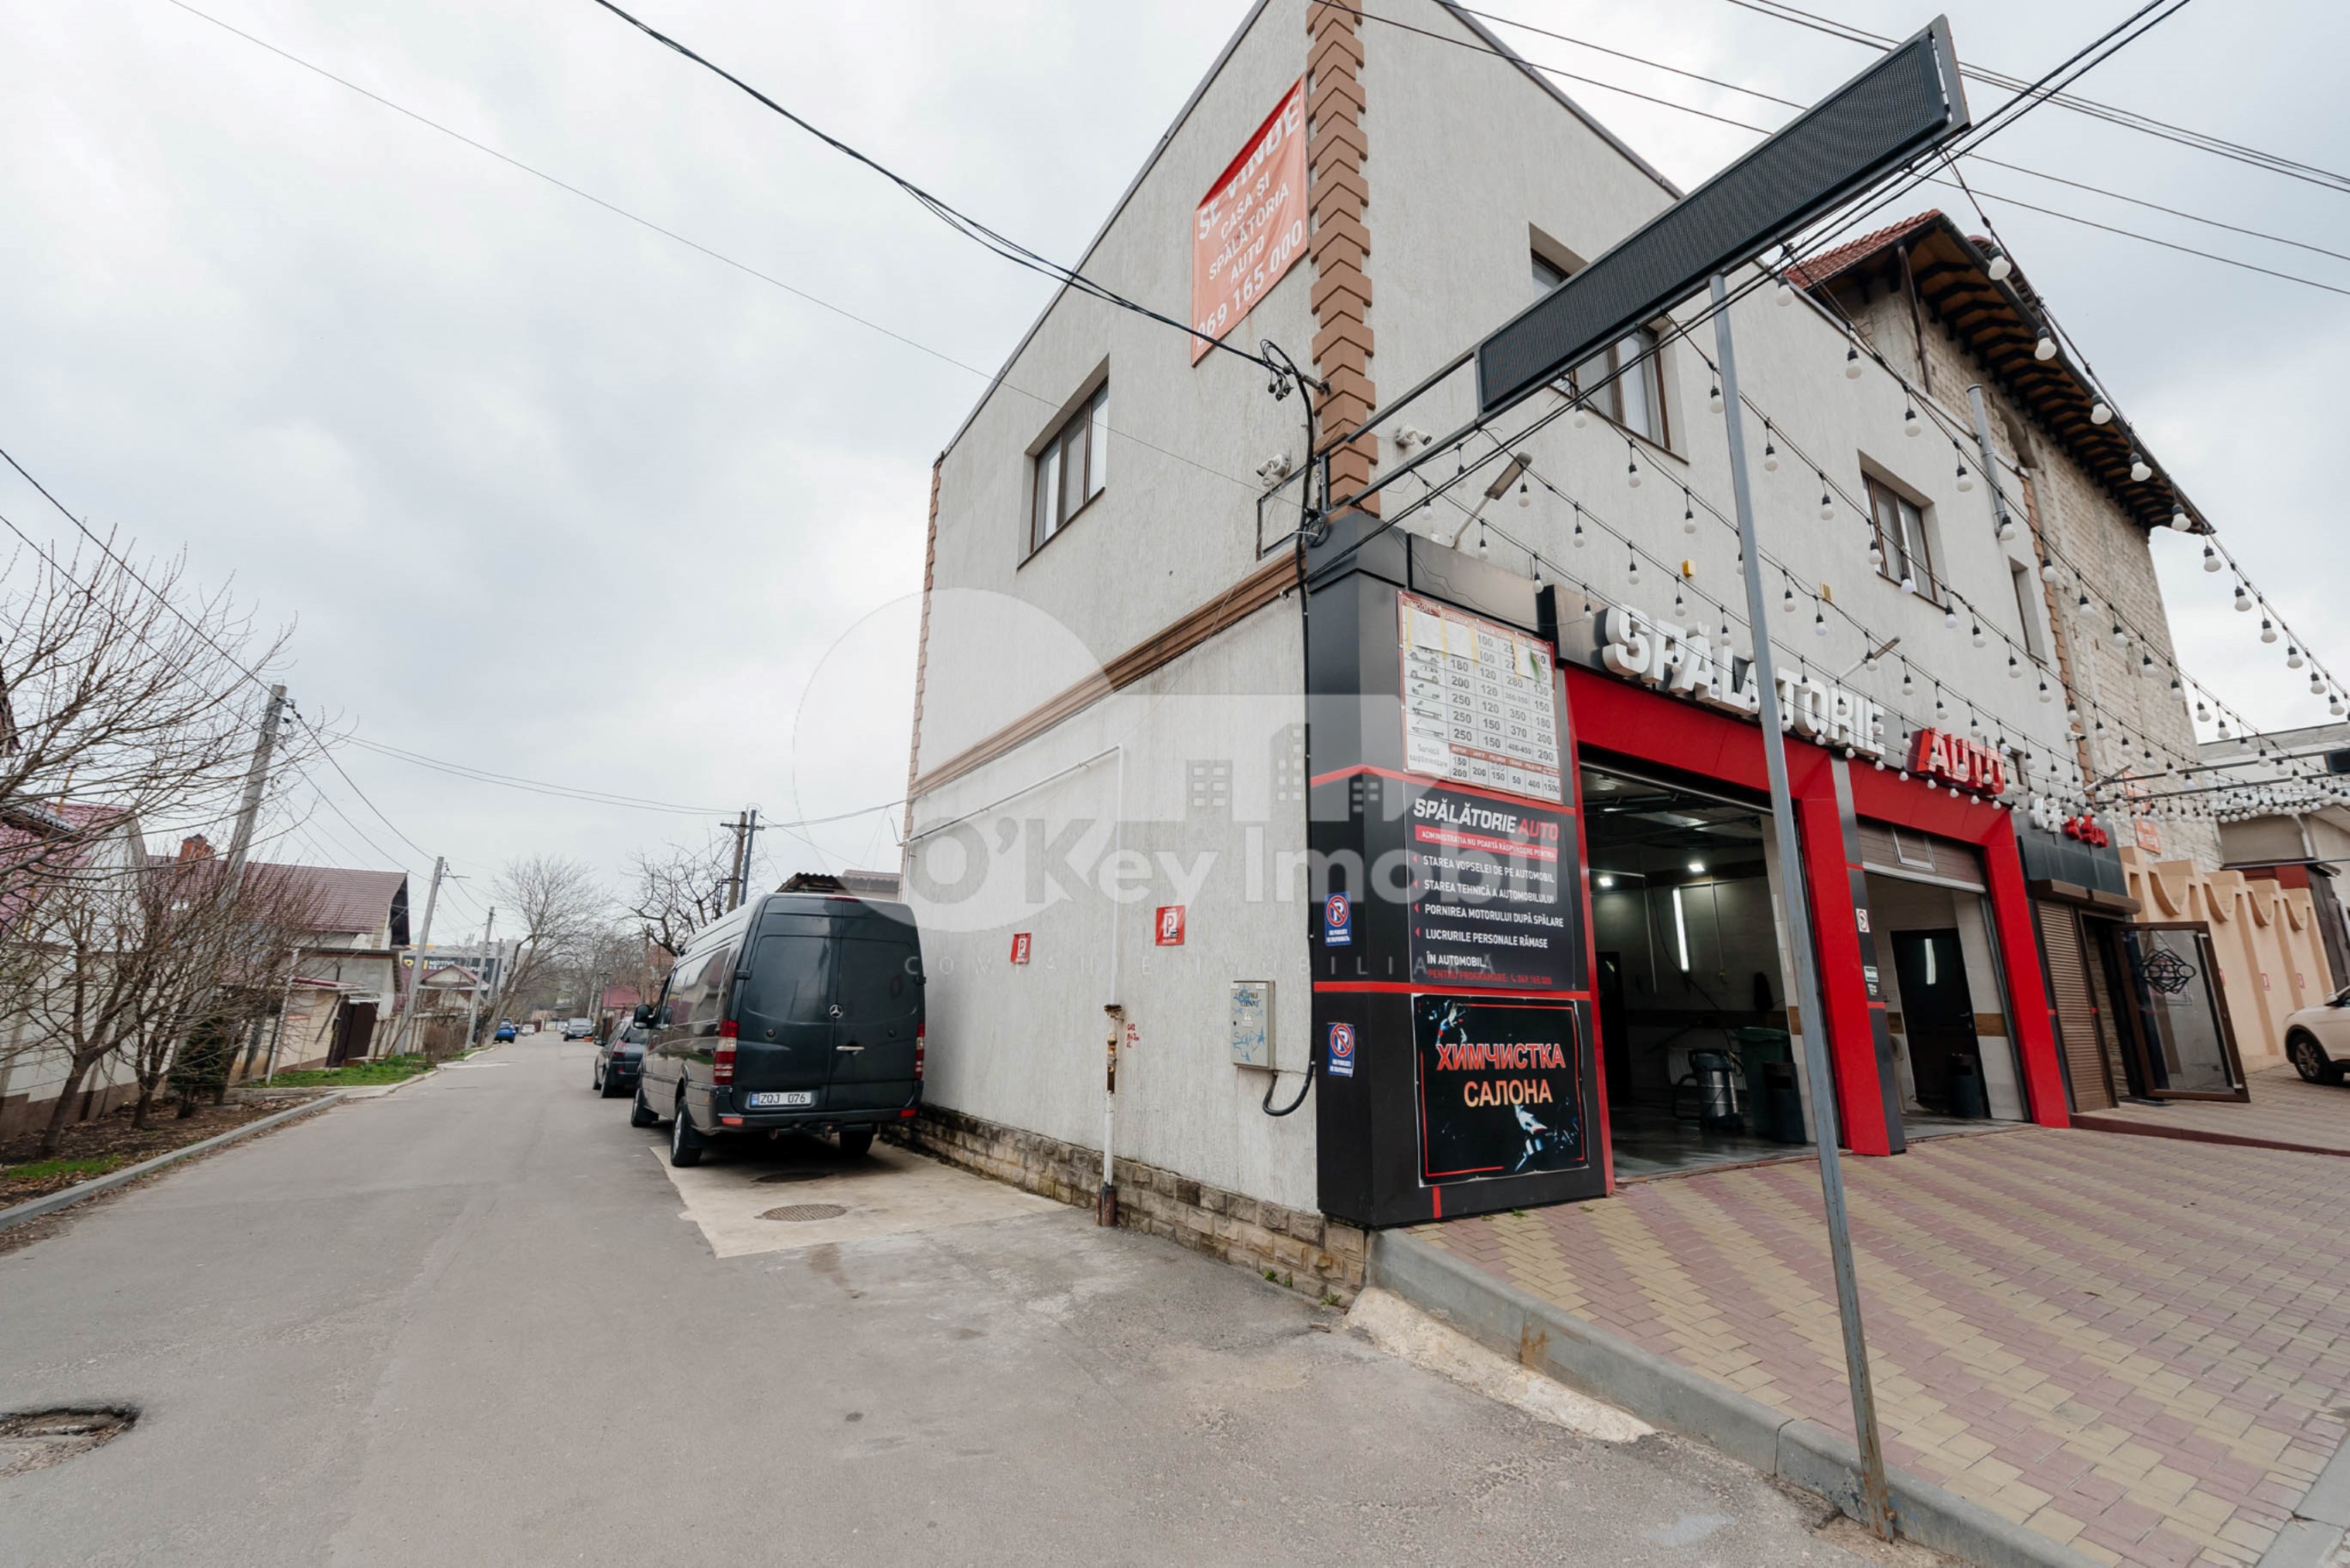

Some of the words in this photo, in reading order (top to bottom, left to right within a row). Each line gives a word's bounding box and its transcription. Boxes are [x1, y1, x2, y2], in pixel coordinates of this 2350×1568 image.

[1199, 199, 1221, 241] SE
[1208, 183, 1289, 282] SPĂLĂTORIA
[1221, 198, 1254, 240] CASA
[1230, 235, 1264, 285] AUTO
[1196, 302, 1228, 346] 069
[1233, 267, 1264, 312] 165
[1269, 219, 1303, 273] 000
[1477, 635, 1494, 647] 100
[1479, 651, 1495, 664] 100
[1451, 659, 1469, 672] 180
[1481, 668, 1497, 680] 120
[1507, 676, 1524, 688] 280
[1452, 676, 1470, 689] 200
[1481, 684, 1498, 696] 120
[1535, 700, 1549, 713] 150
[1452, 693, 1470, 707] 250
[1482, 701, 1500, 714] 120
[1509, 708, 1526, 721] 350
[1536, 717, 1551, 729] 180
[1453, 710, 1472, 724] 250
[1483, 718, 1501, 731] 150
[1511, 726, 1527, 738] 370
[1537, 732, 1552, 745] 200
[1453, 728, 1472, 742] 250
[1484, 736, 1501, 749] 150
[1538, 750, 1554, 763] 200
[1452, 757, 1467, 766] 150
[1916, 728, 2006, 794] AUTO
[1452, 768, 1468, 778] 200
[1472, 767, 1487, 777] 200
[1491, 771, 1506, 781] 150
[1512, 775, 1521, 785] 50
[1528, 780, 1541, 789] 400
[1413, 798, 1518, 834] SPĂLĂTORIE
[1518, 817, 1560, 841] AUTO
[1423, 855, 1455, 869] STAREA
[1455, 860, 1492, 873] VOPSELEI
[1493, 865, 1504, 876] DE
[1504, 866, 1513, 878] PE
[1515, 867, 1555, 883] AUTOMOBIL
[1424, 879, 1456, 893] STAREA
[1458, 883, 1491, 897] TEHNICĂ
[1492, 889, 1498, 897] A
[1499, 889, 1555, 904] AUTOMOBILULUI
[1425, 903, 1467, 918] PORNIREA
[1468, 909, 1513, 922] MOTORULUI
[1513, 911, 1533, 925] DUPĂ
[1533, 914, 1564, 927] SPĂLARE
[1426, 928, 1471, 943] LUCRURILE
[1472, 932, 1519, 946] PERSONALE
[1519, 934, 1549, 949] RĂMASE
[1427, 951, 1437, 965] ÎN
[1428, 969, 1458, 980] PENTRU
[1436, 1043, 1567, 1071] ХИМЧИСТКА
[760, 1094, 780, 1104] ZQJ
[788, 1093, 806, 1103] 076
[1464, 1079, 1554, 1108] САЛОНА
